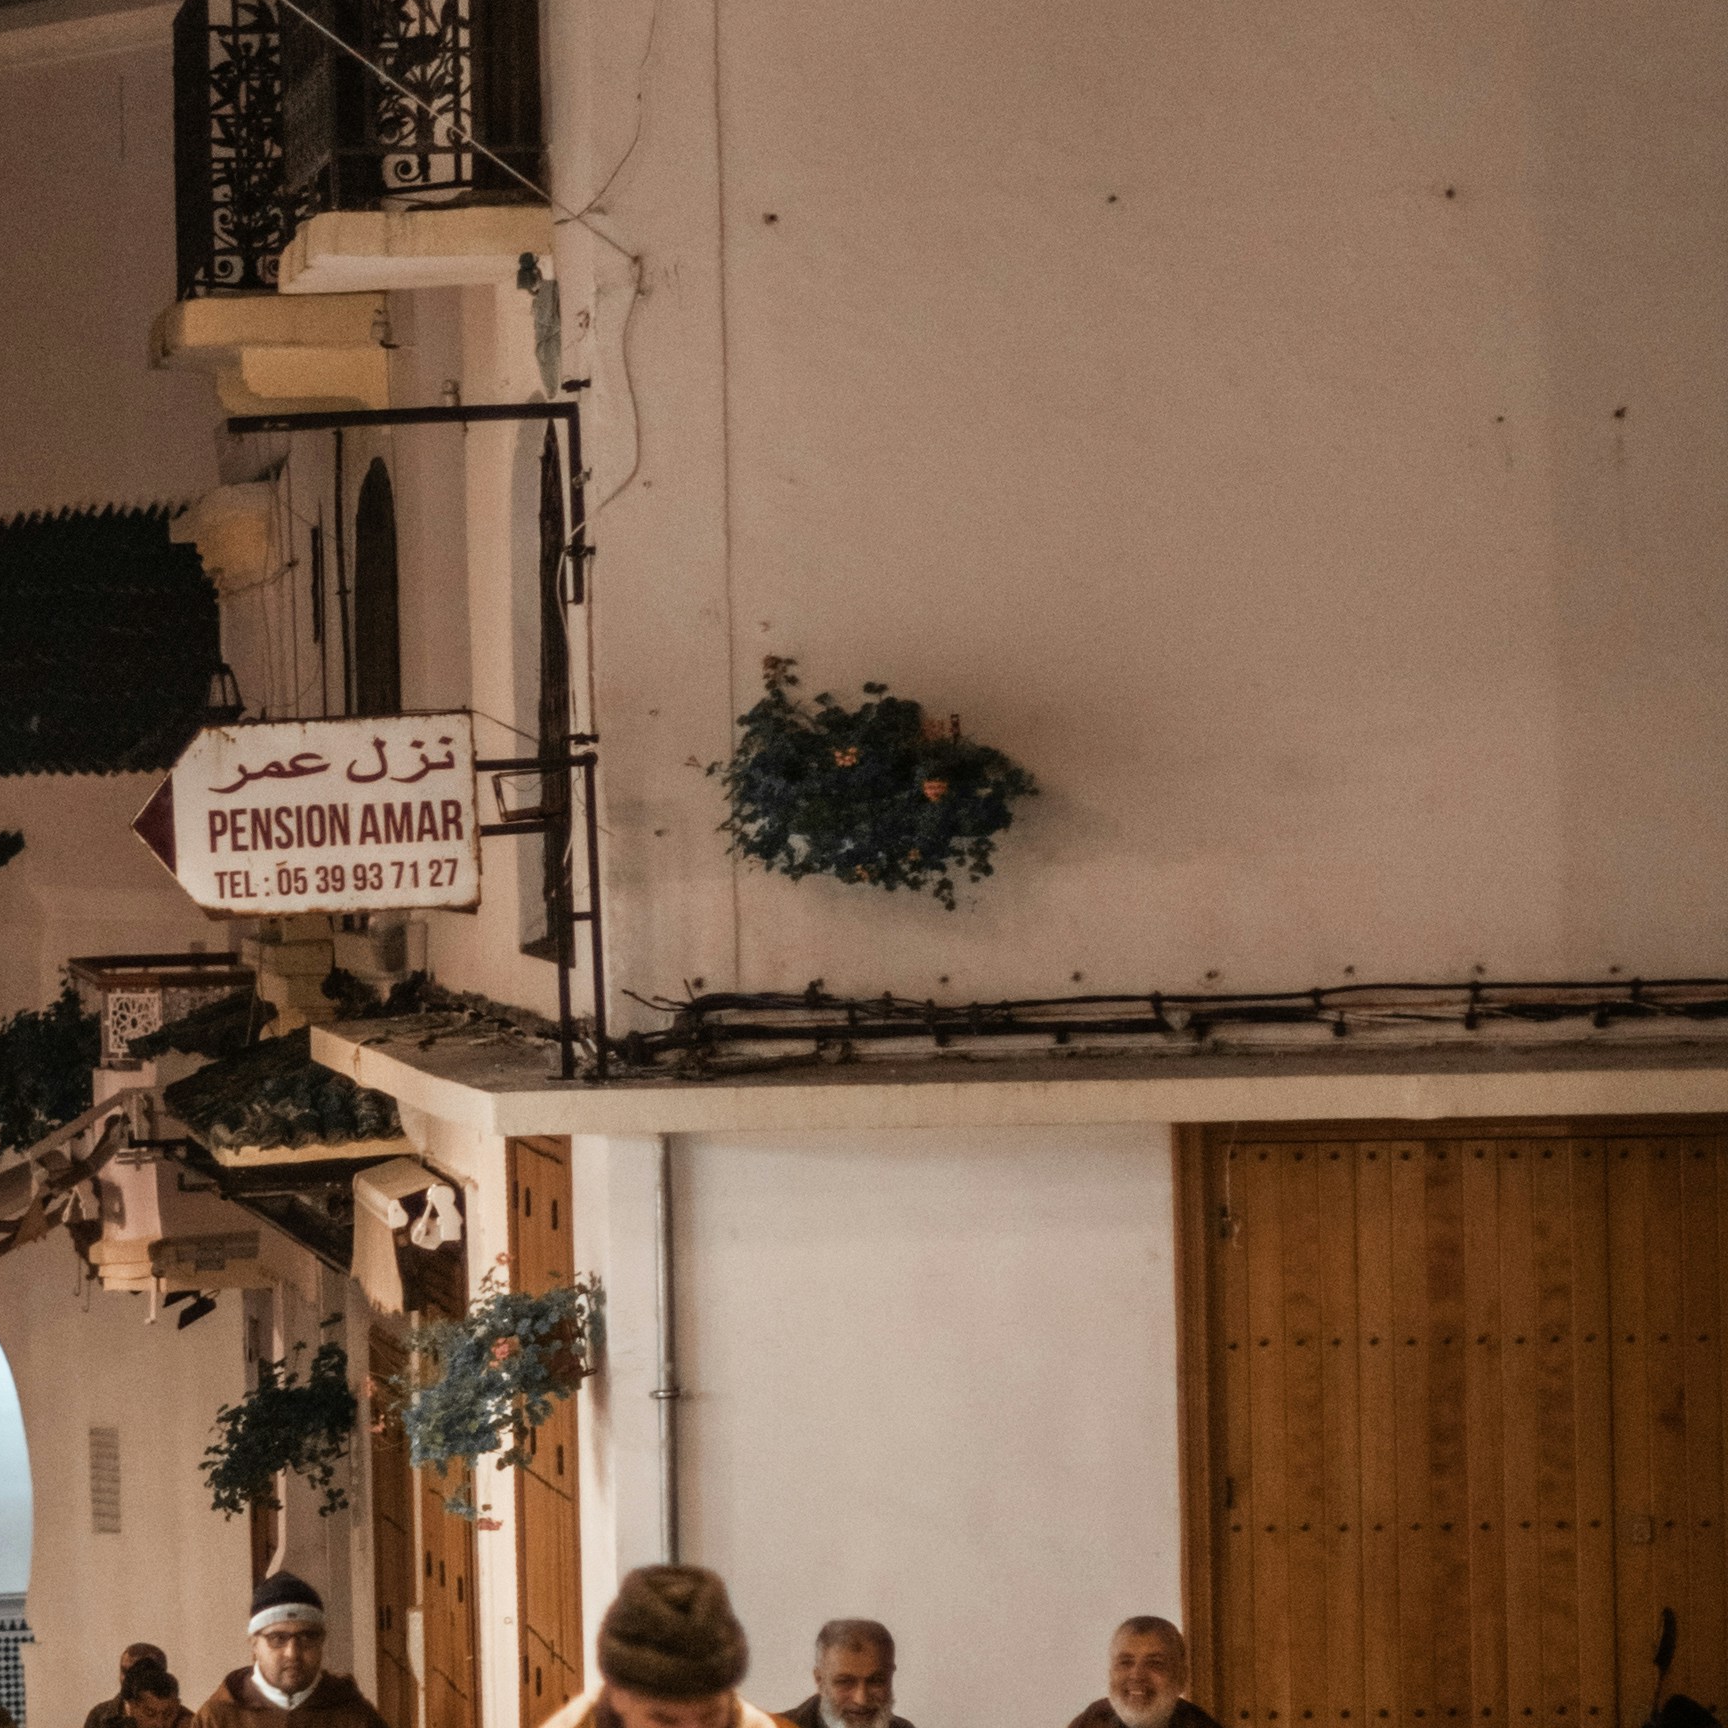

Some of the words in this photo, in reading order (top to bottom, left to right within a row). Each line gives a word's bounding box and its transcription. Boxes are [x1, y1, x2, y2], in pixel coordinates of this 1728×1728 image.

[208, 752, 332, 794] عمر
[346, 735, 455, 784] نزل
[208, 802, 351, 854] PENSION
[358, 798, 464, 846] AMAR
[277, 866, 309, 897] 05
[316, 864, 346, 894] 39
[353, 863, 384, 892] 93
[391, 860, 420, 890] 71
[429, 858, 459, 888] 27
